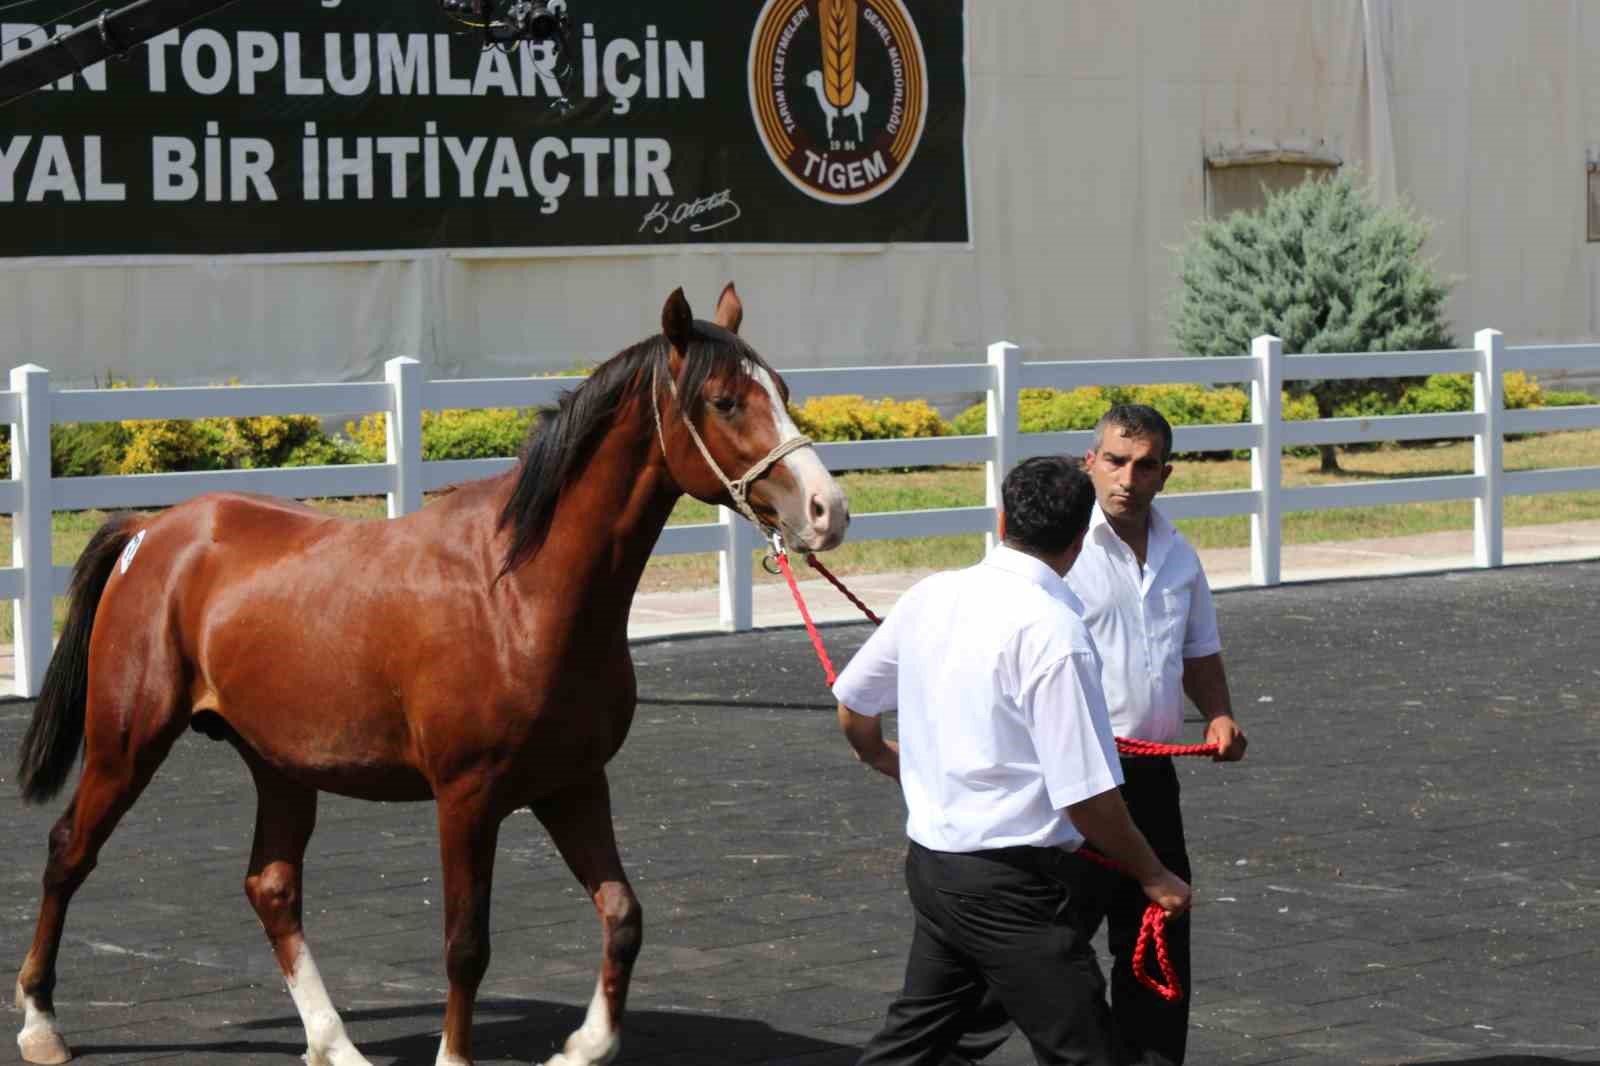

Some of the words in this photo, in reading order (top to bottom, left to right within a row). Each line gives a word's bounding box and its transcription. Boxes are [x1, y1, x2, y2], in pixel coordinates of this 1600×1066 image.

[145, 28, 562, 97] TOPLUMLAR
[582, 22, 705, 115] İÇİN
[775, 89, 797, 136] TARIM
[152, 121, 278, 202] BİR
[302, 120, 674, 214] İHTİYAÇTIR
[802, 149, 888, 190] TİGEM
